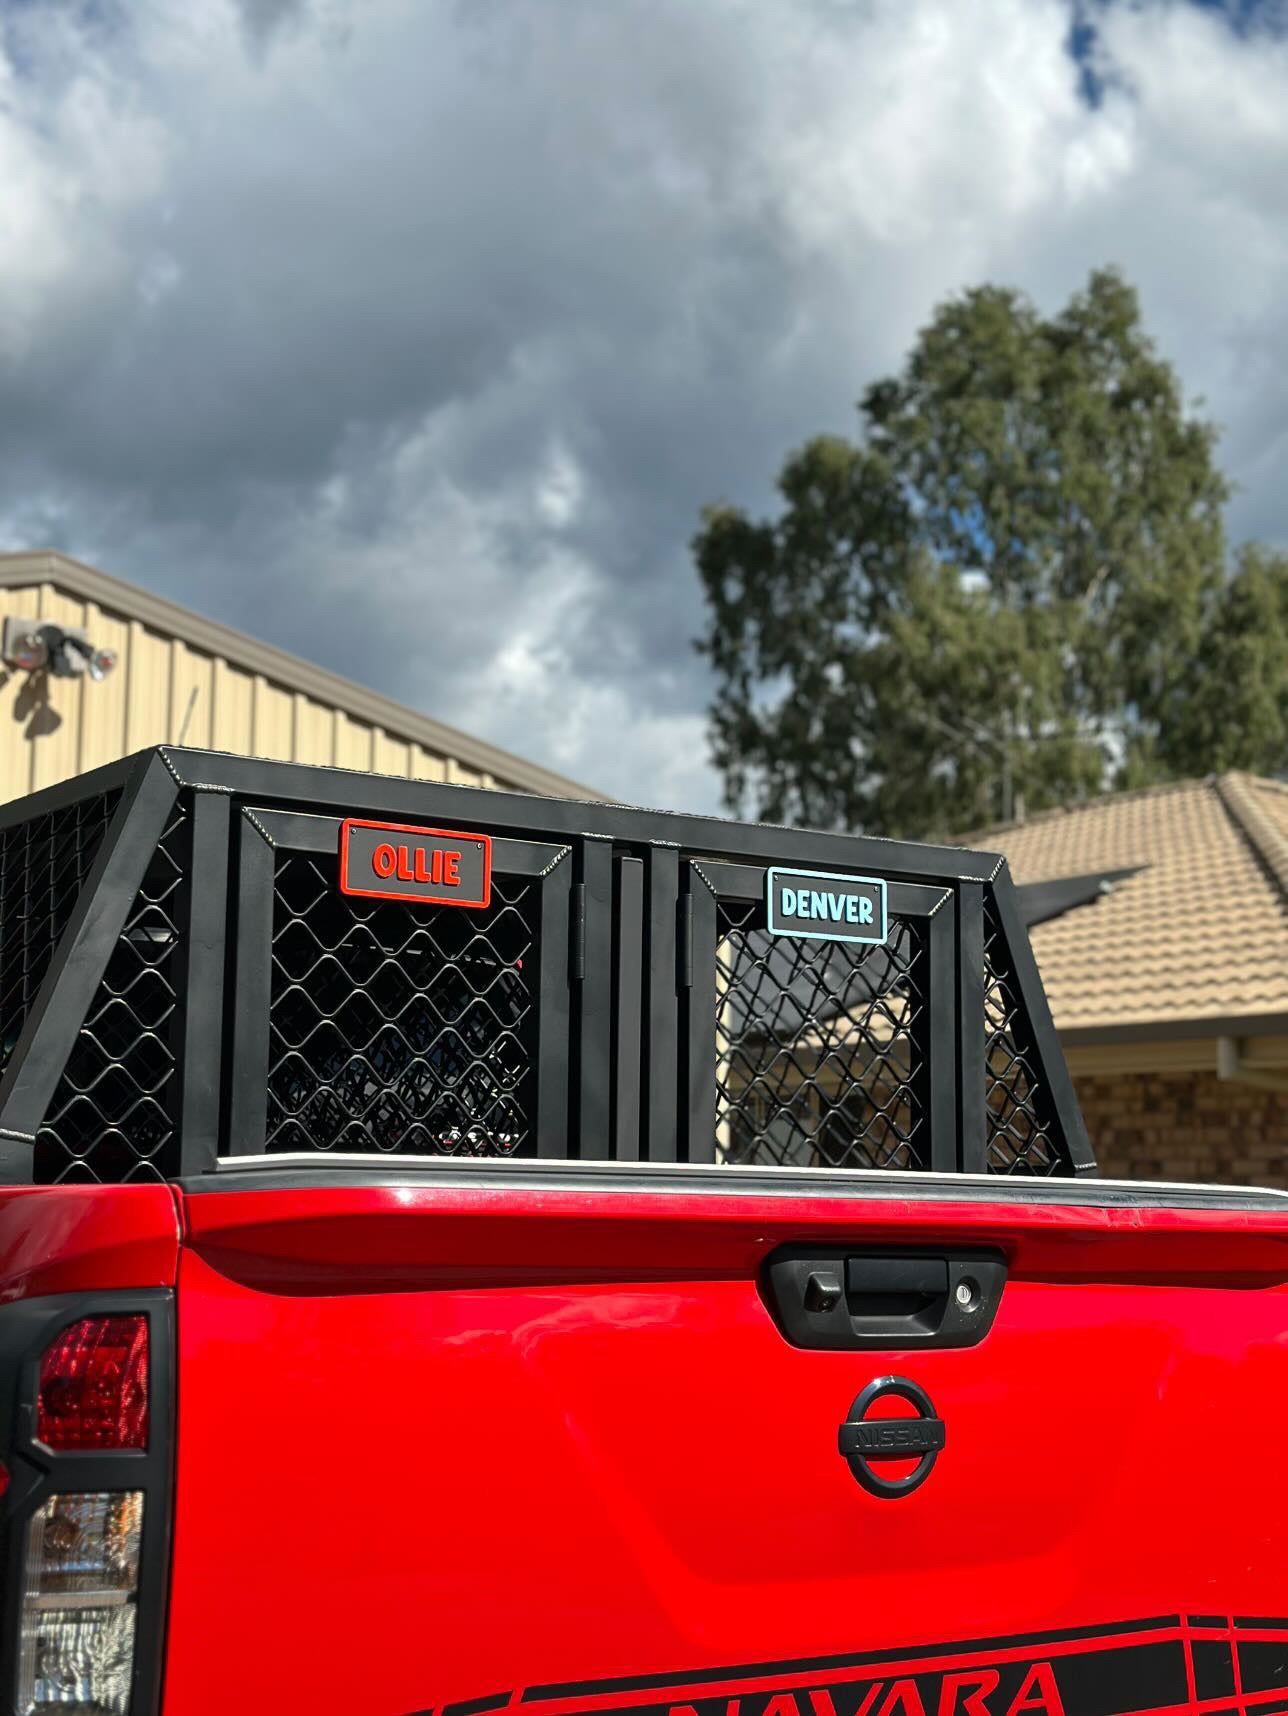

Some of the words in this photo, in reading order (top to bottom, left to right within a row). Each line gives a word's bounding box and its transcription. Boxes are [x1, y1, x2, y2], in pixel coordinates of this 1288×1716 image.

[373, 843, 462, 886] OLLIE
[781, 887, 874, 924] DENVER
[667, 1662, 1066, 1716] VARA
